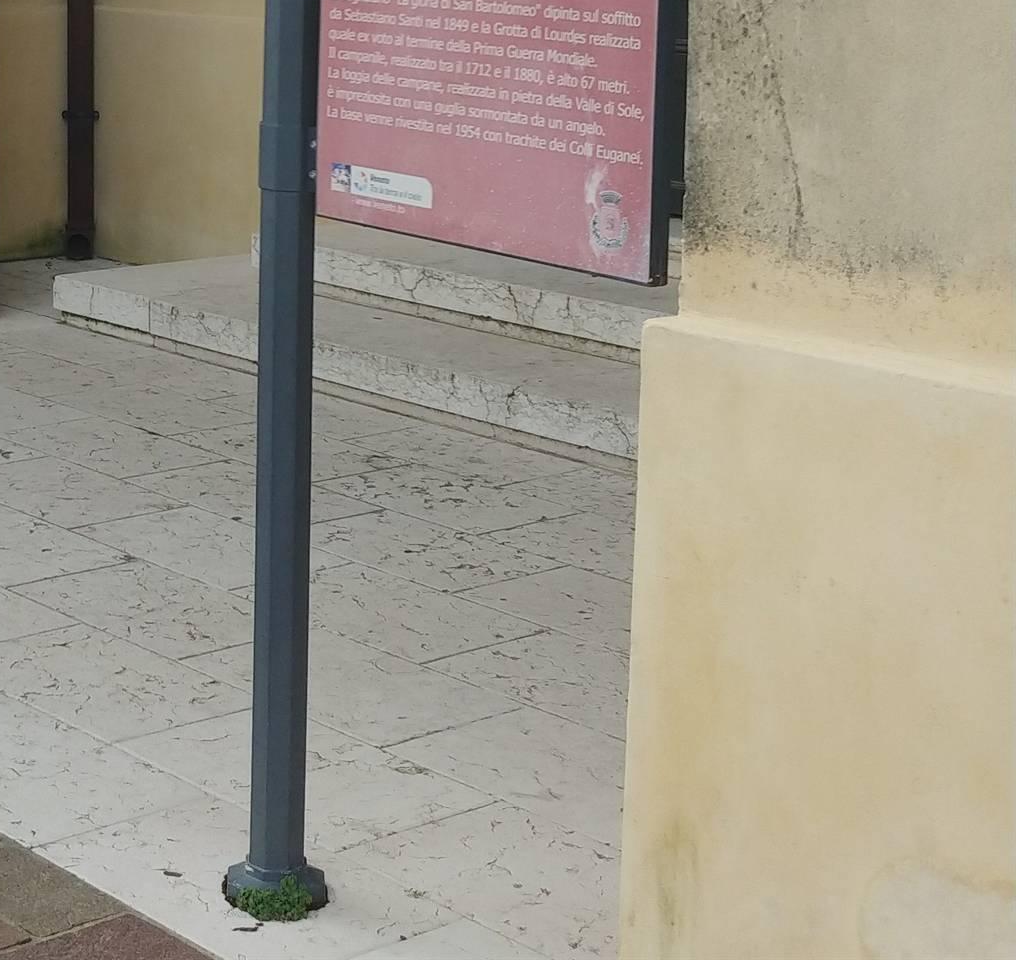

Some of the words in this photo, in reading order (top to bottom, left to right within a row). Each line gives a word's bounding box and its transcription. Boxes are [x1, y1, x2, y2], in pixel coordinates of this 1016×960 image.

[544, 5, 580, 22] dipinta
[584, 9, 599, 23] sul
[602, 11, 641, 27] soffitto
[471, 22, 480, 32] e
[481, 20, 491, 33] la
[493, 21, 528, 38] Grotta
[530, 25, 542, 39] di
[544, 26, 586, 44] Lourdes
[589, 33, 641, 50] realizzata
[473, 41, 504, 57] Prima
[507, 44, 544, 61] Guerra
[546, 48, 598, 67] Mondiale.
[466, 61, 491, 76] 1712
[494, 67, 502, 78] e
[504, 66, 510, 79] il
[547, 71, 554, 85] è
[557, 73, 578, 88] alto
[581, 75, 595, 90] 67
[598, 79, 630, 94] metri.
[498, 86, 509, 100] in
[512, 88, 542, 104] pietra
[546, 92, 572, 109] della
[576, 96, 601, 113] Valle
[604, 100, 614, 115] di
[618, 102, 645, 120] Sole,
[468, 107, 528, 125] sormontata
[531, 112, 544, 127] da
[548, 118, 563, 130] un
[566, 120, 606, 136] angelo.
[456, 123, 480, 139] 1954
[484, 130, 502, 143] con
[506, 130, 546, 150] trachite
[549, 137, 566, 153] dei
[596, 144, 644, 164] Euganei.
